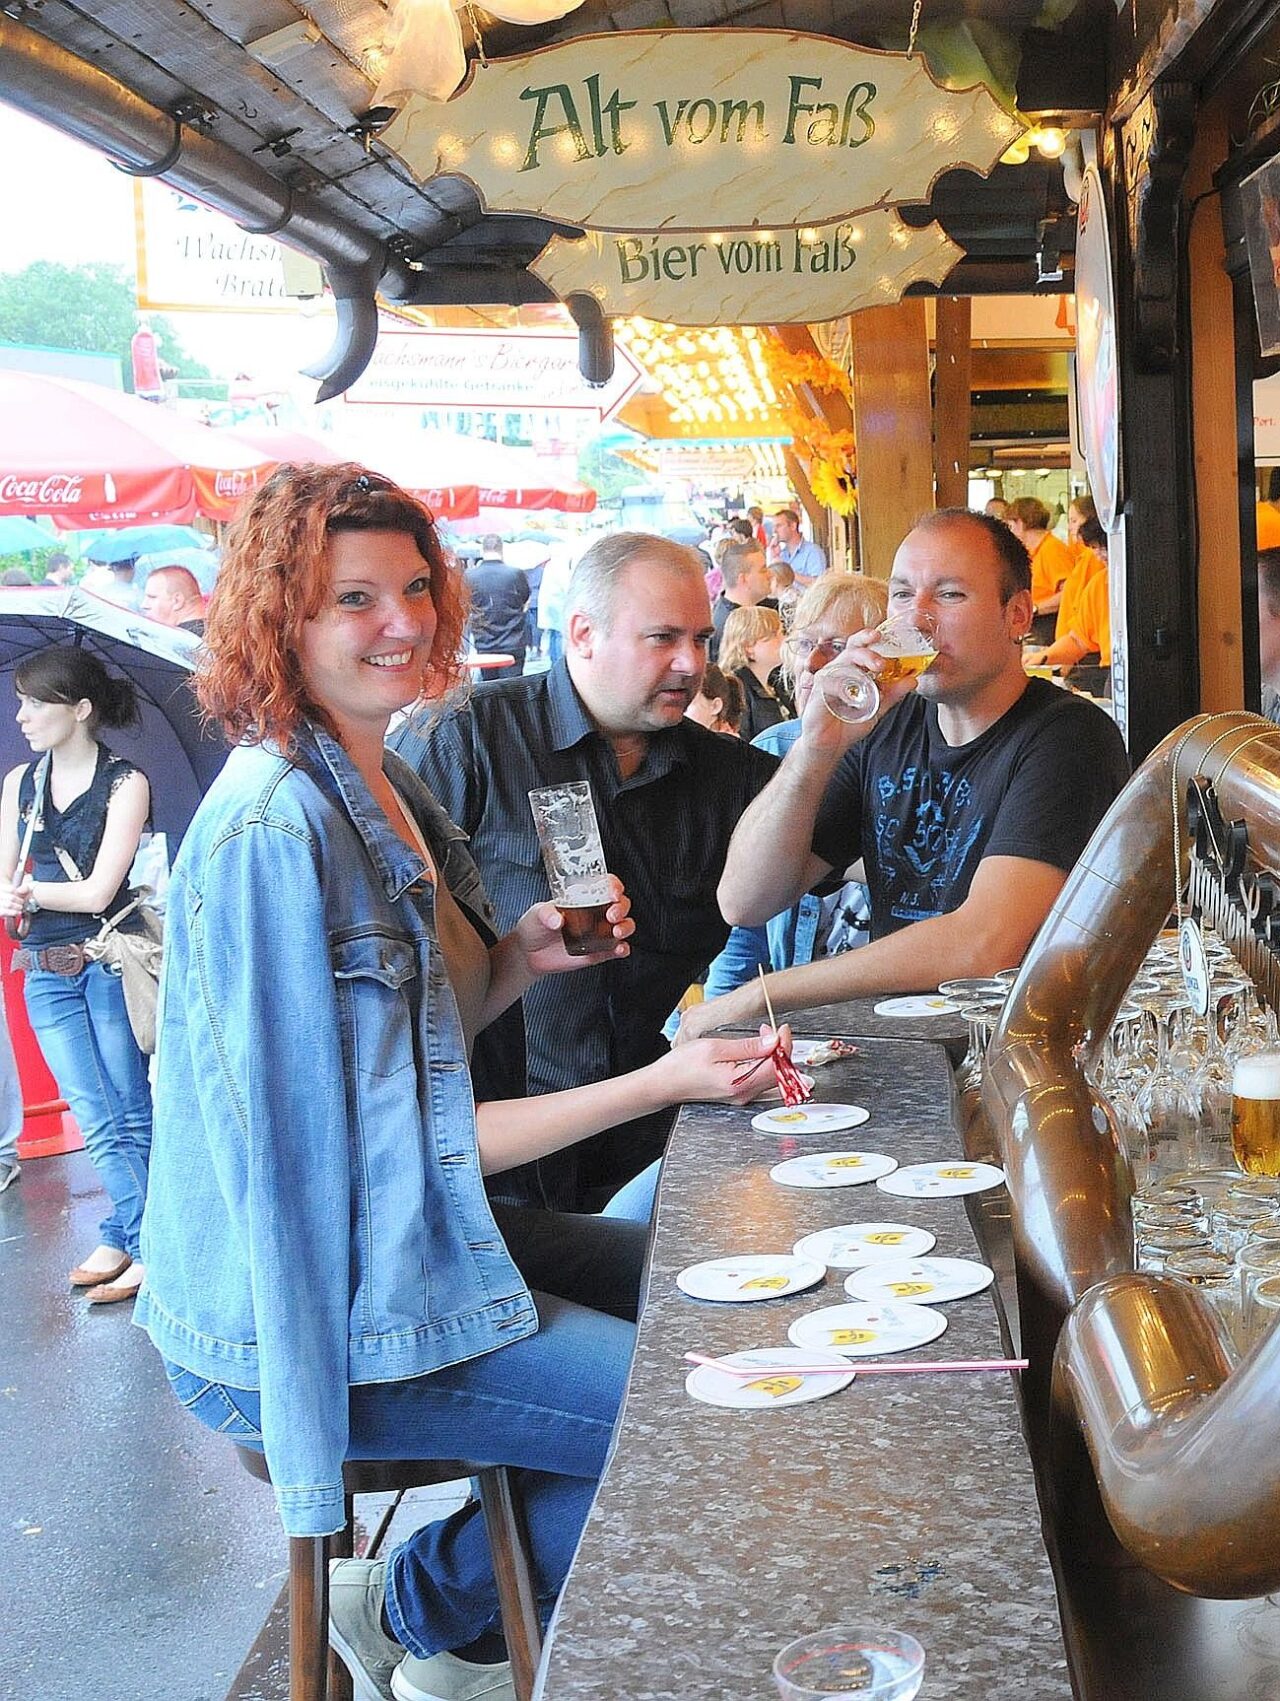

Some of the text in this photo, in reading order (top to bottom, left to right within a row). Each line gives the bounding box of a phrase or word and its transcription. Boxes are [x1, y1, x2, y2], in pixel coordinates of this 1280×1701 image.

[517, 73, 877, 172] Alt vom Faß
[615, 223, 857, 284] Bier vom Faß
[0, 474, 84, 505] Coca-Cola
